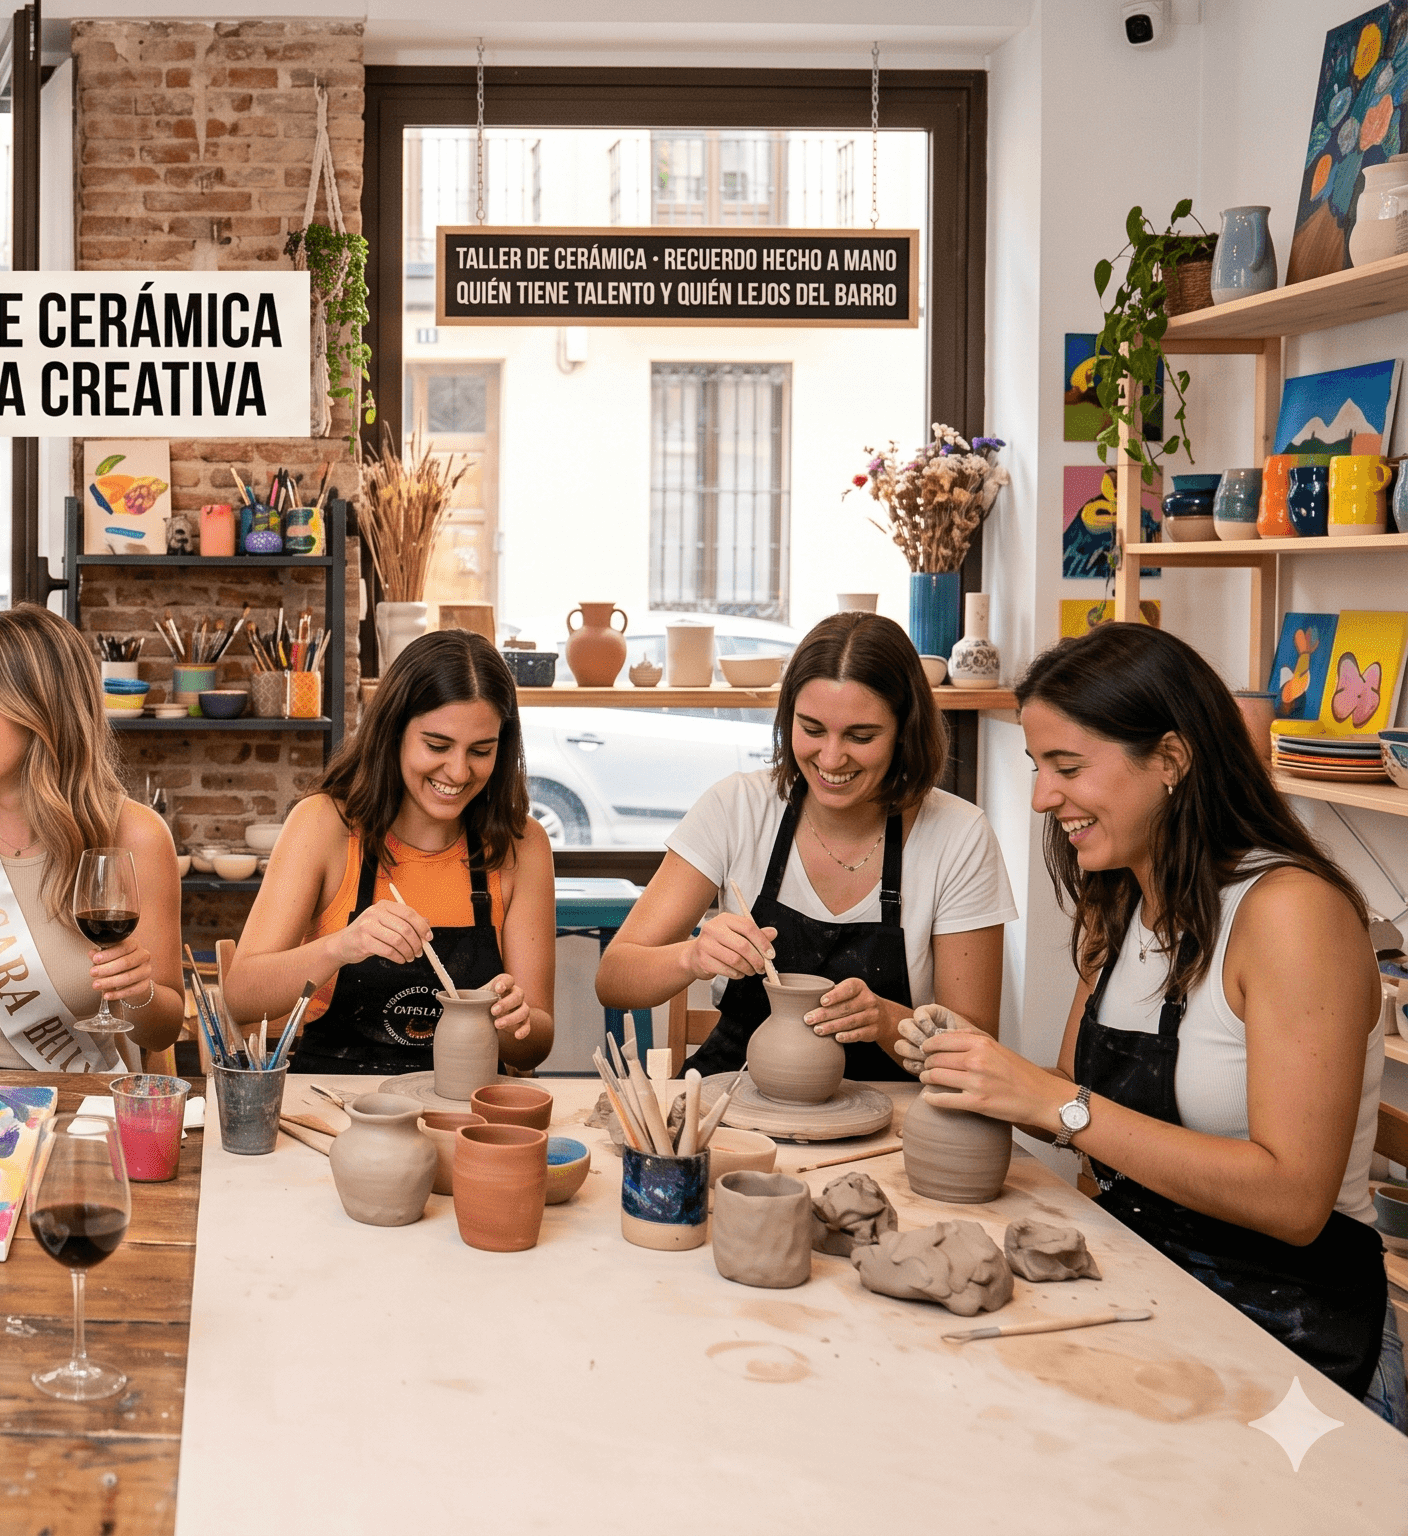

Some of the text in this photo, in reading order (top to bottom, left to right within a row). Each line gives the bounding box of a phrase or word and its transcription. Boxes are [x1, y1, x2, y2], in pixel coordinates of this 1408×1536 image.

[456, 247, 522, 270] TALLER
[527, 247, 550, 270] DE
[554, 243, 648, 270] CERÁMICA
[664, 247, 758, 271] RECUERDO
[762, 248, 822, 271] HECHO
[826, 248, 840, 271] A
[844, 249, 898, 271] MANO
[456, 277, 898, 307] QUIÉN TIENE TALENTO Y QUIÉN LEJOS DEL BARRO
[39, 281, 283, 348] CERÁMICA
[41, 360, 268, 417] CREATIVA
